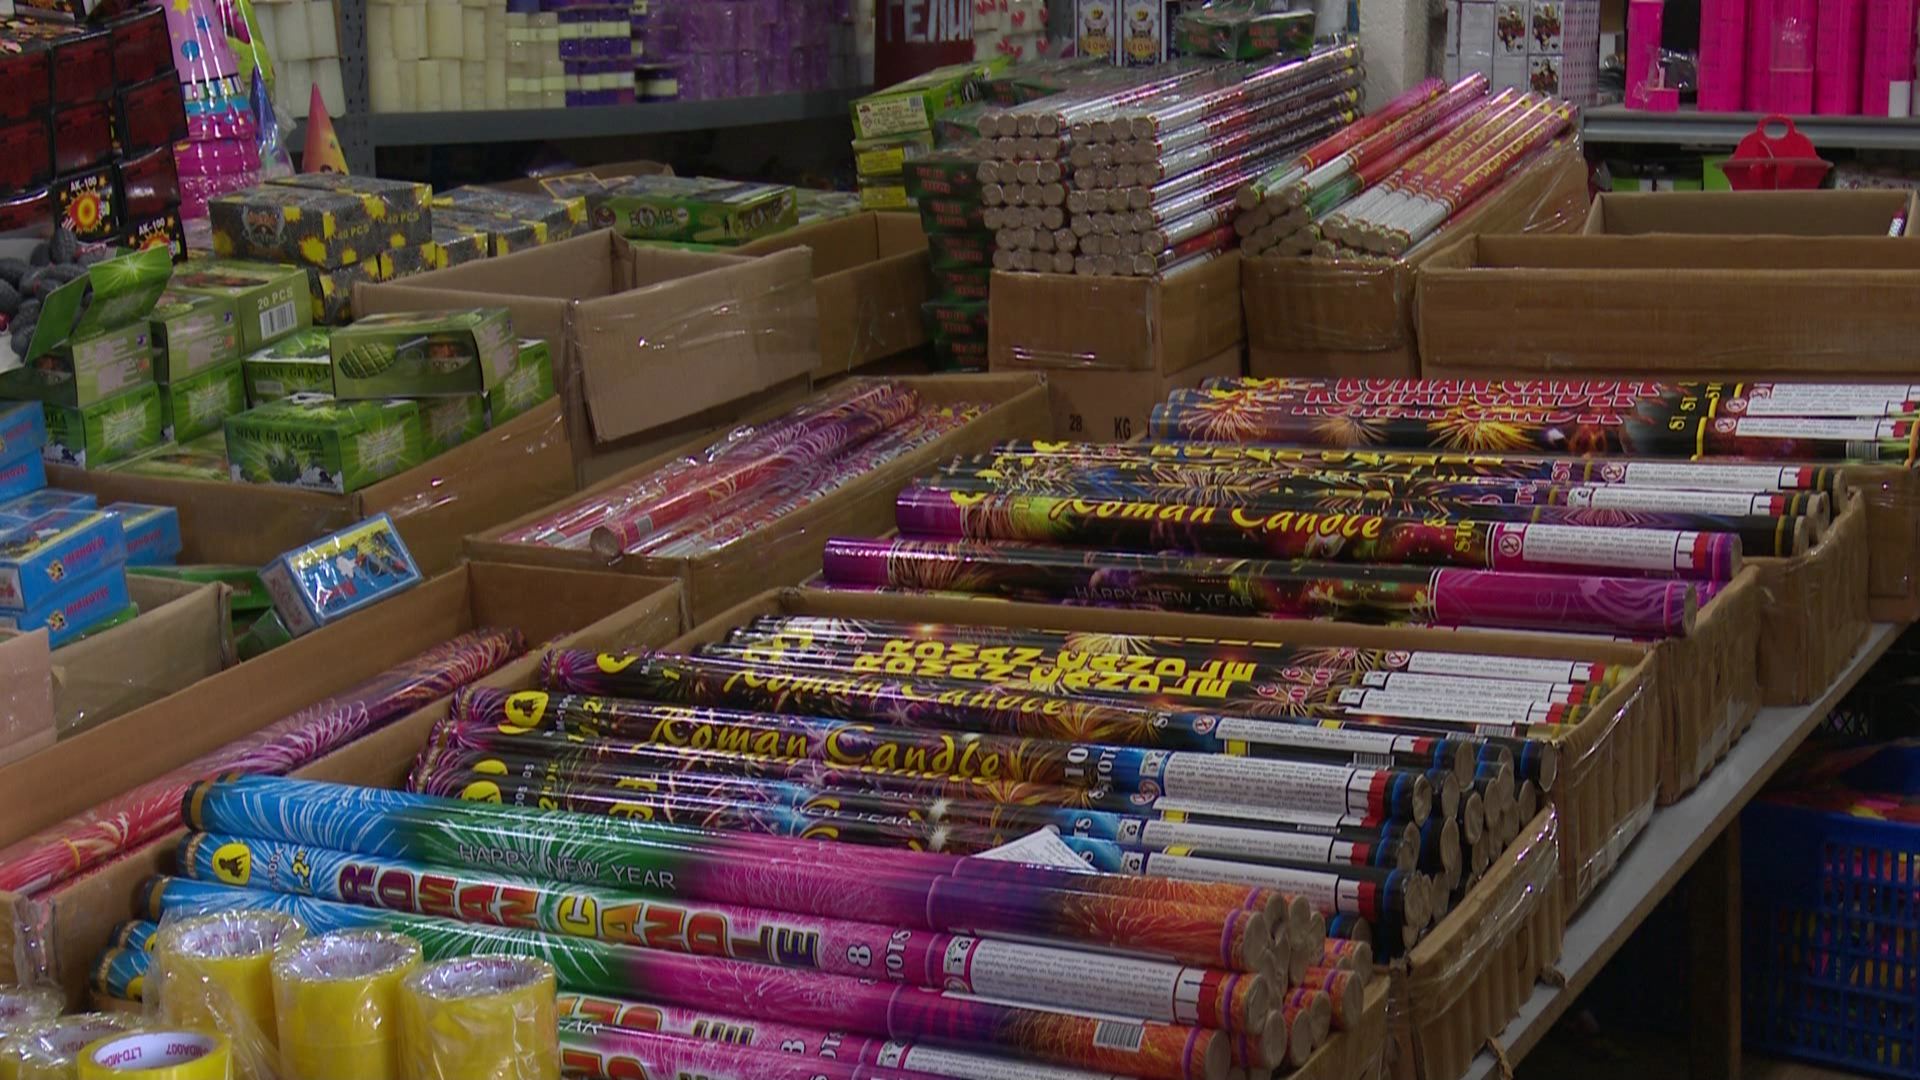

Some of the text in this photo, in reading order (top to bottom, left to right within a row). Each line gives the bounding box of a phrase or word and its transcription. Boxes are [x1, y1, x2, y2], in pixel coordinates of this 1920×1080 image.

[70, 175, 97, 192] AK-100
[138, 217, 166, 235] AK-100
[257, 286, 294, 310] 20 PCS
[265, 430, 323, 446] GRANADA
[1069, 414, 1132, 441] 28 KG
[1146, 589, 1193, 605] NEW
[1200, 593, 1255, 609] YEAR
[883, 639, 1258, 682] ROMAN CANDLE
[853, 654, 1234, 698] ROMAN CANDLE
[650, 704, 1002, 780] Roman Candle
[1065, 747, 1088, 778] 10
[459, 844, 677, 891] HAPPY NEW YEAR
[339, 862, 822, 970] ROMAN CANDLE
[848, 944, 873, 968] 8
